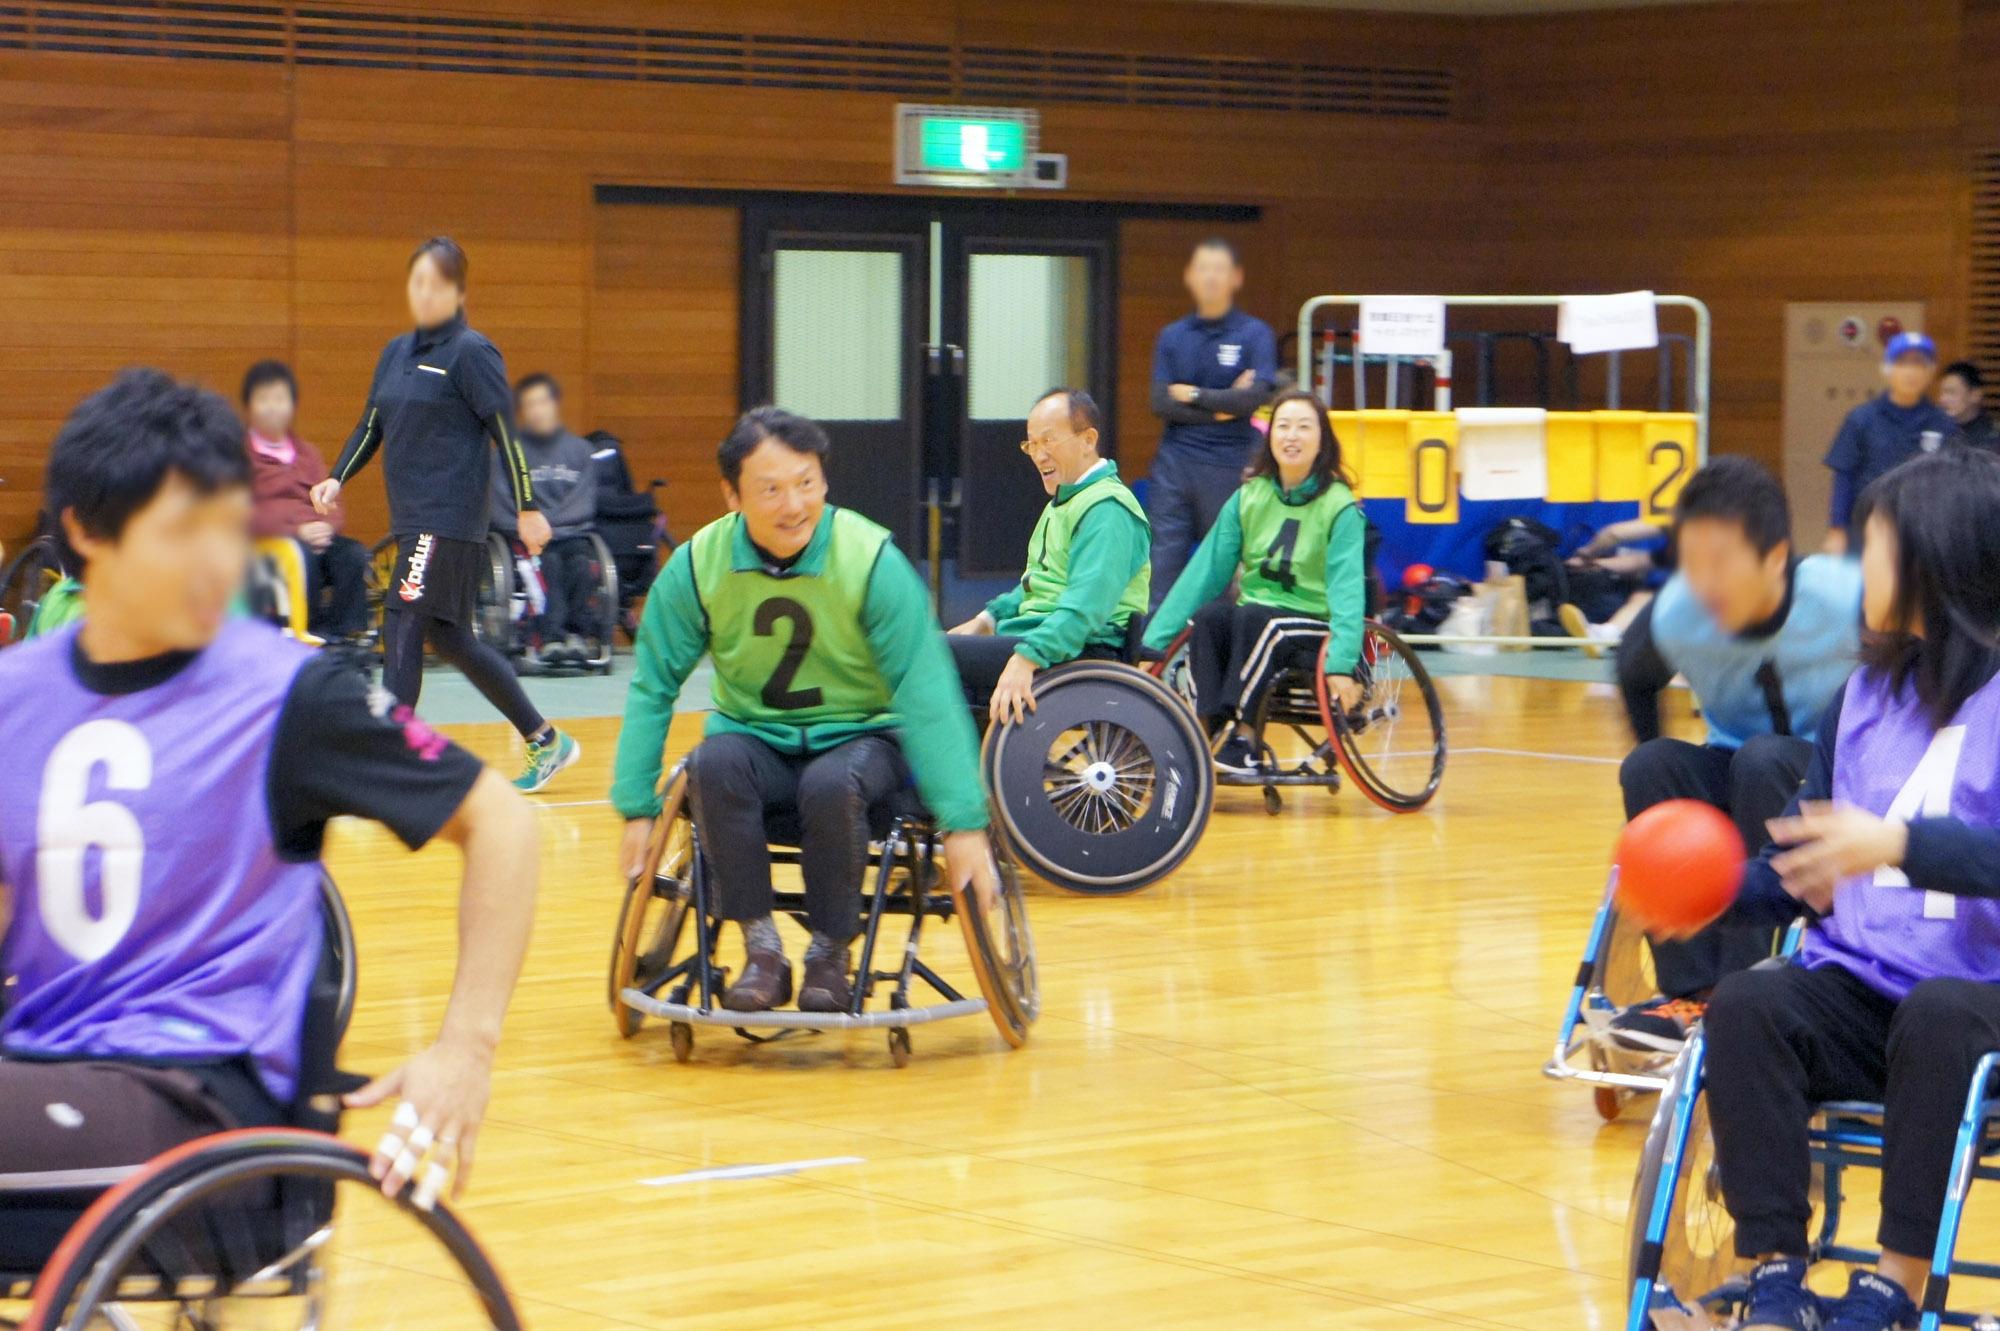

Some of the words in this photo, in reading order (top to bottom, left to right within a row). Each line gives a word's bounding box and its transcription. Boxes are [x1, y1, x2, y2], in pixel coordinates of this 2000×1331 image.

[1415, 438, 1449, 513] 0
[1649, 441, 1685, 515] 2
[1260, 518, 1301, 593] 4
[754, 597, 824, 710] 2
[37, 718, 152, 963] 6
